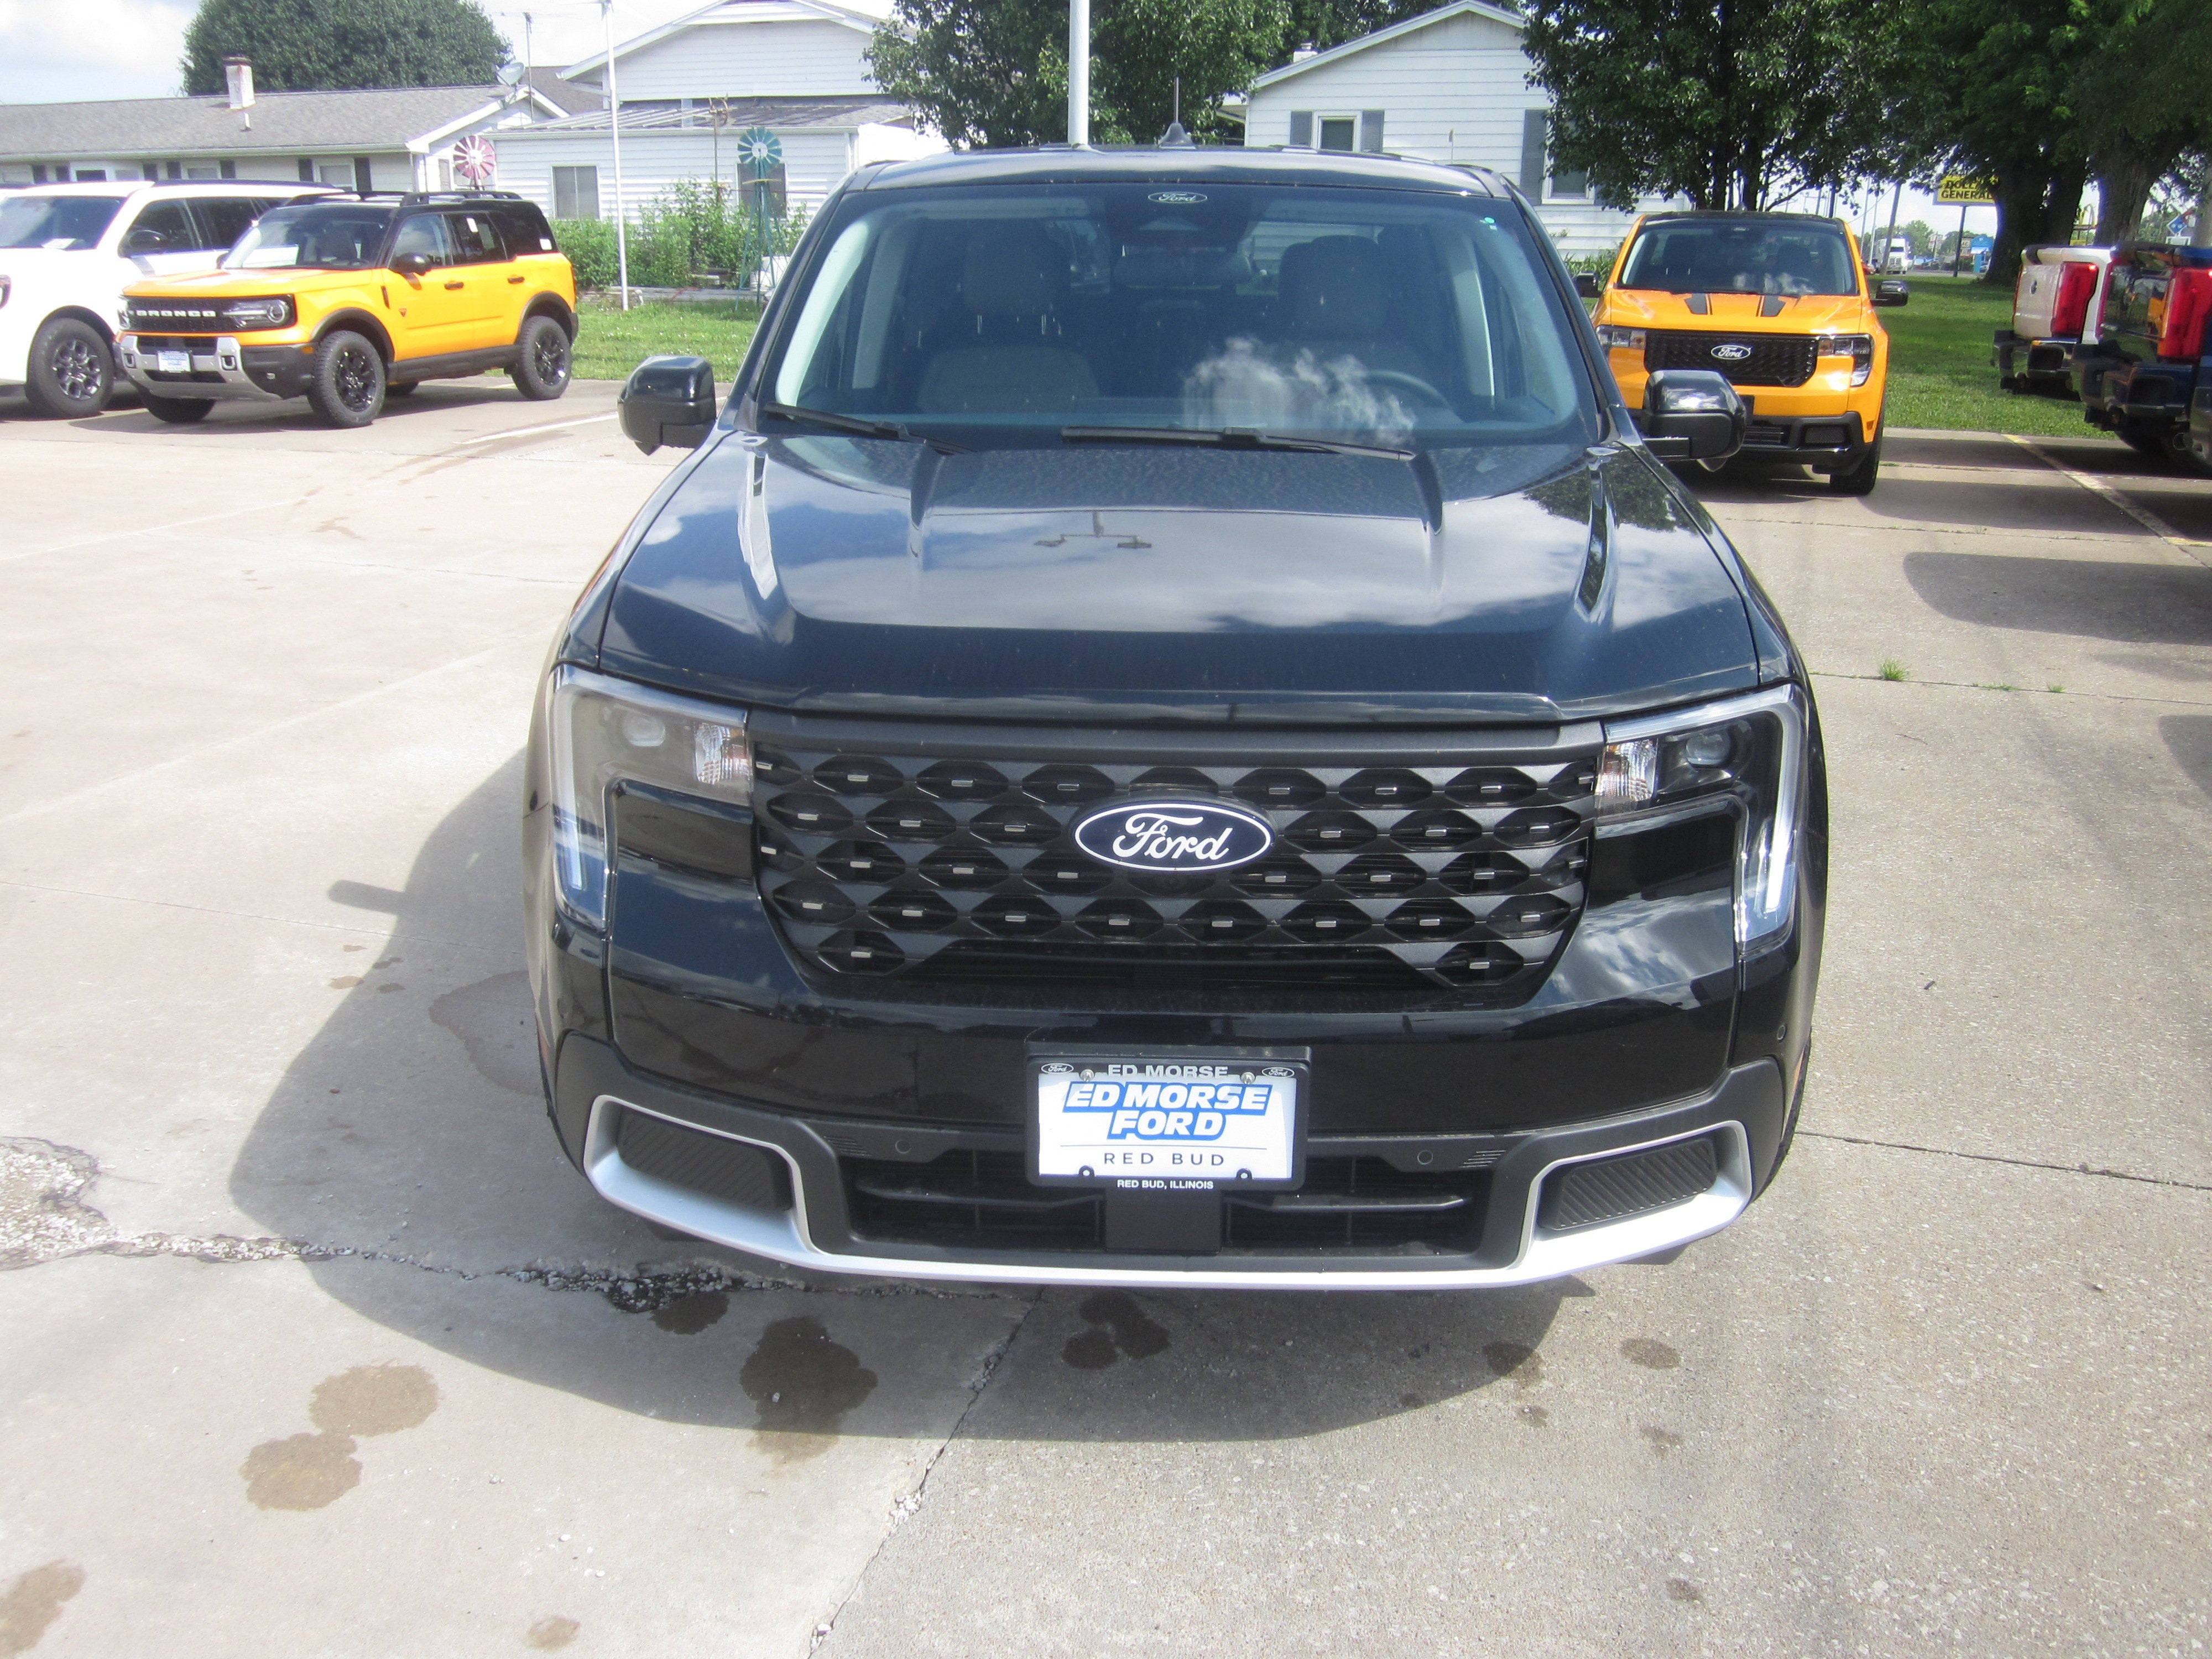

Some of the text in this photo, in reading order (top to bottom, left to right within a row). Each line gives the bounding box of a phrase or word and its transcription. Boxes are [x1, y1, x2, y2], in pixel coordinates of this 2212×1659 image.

[1944, 180, 1985, 189] DOLL
[1158, 193, 1197, 201] Ford
[1941, 190, 1993, 199] GENERAL
[1718, 347, 1744, 357] Ford
[1113, 813, 1233, 860] Ford
[1108, 1065, 1228, 1078] ED MORSE
[1065, 1082, 1270, 1110] ED MORSE
[1110, 1110, 1224, 1137] FORD
[1104, 1152, 1224, 1166] RED BUD
[1117, 1180, 1214, 1190] RED BUD, ILLINOIS
